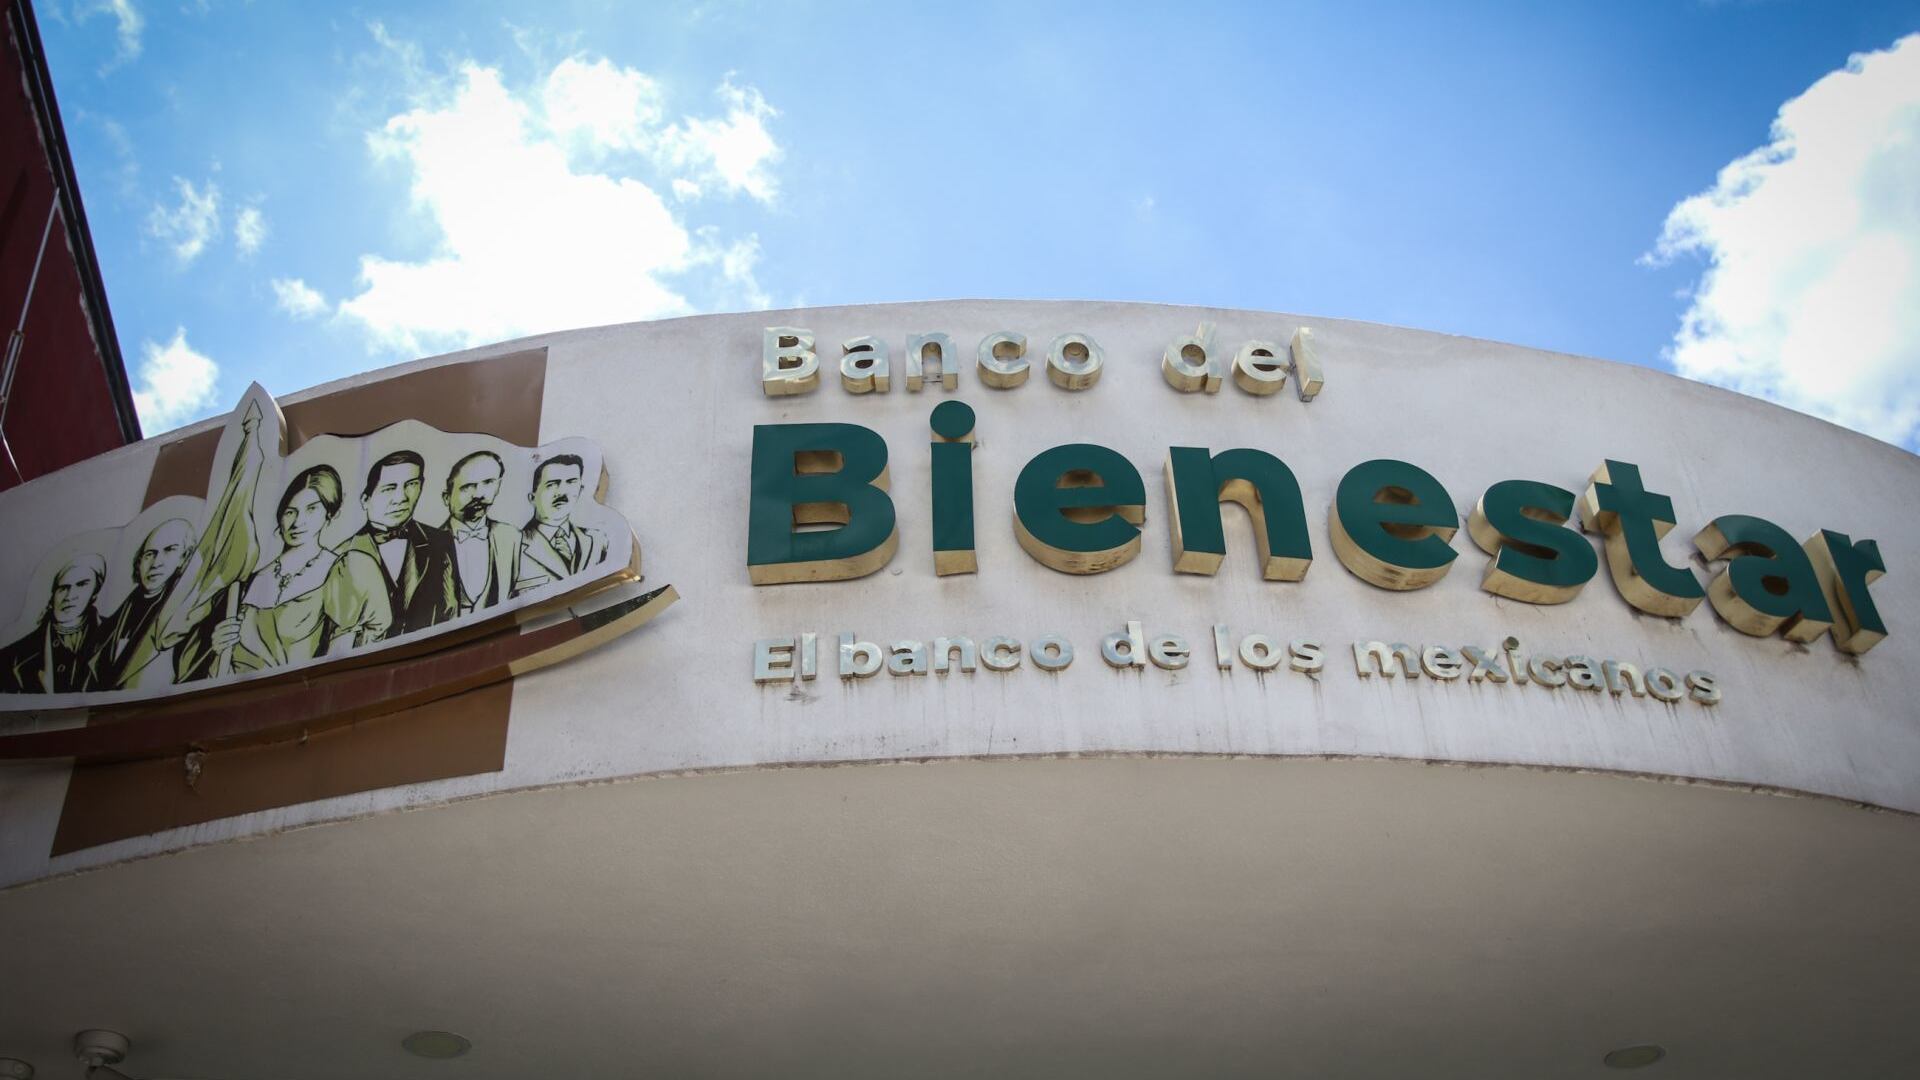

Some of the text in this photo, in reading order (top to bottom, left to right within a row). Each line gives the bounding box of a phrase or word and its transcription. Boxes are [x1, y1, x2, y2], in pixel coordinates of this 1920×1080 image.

[763, 322, 1324, 399] Banco del
[747, 400, 1888, 653] Bienestar
[753, 620, 1721, 705] El banco de los mexicanos
